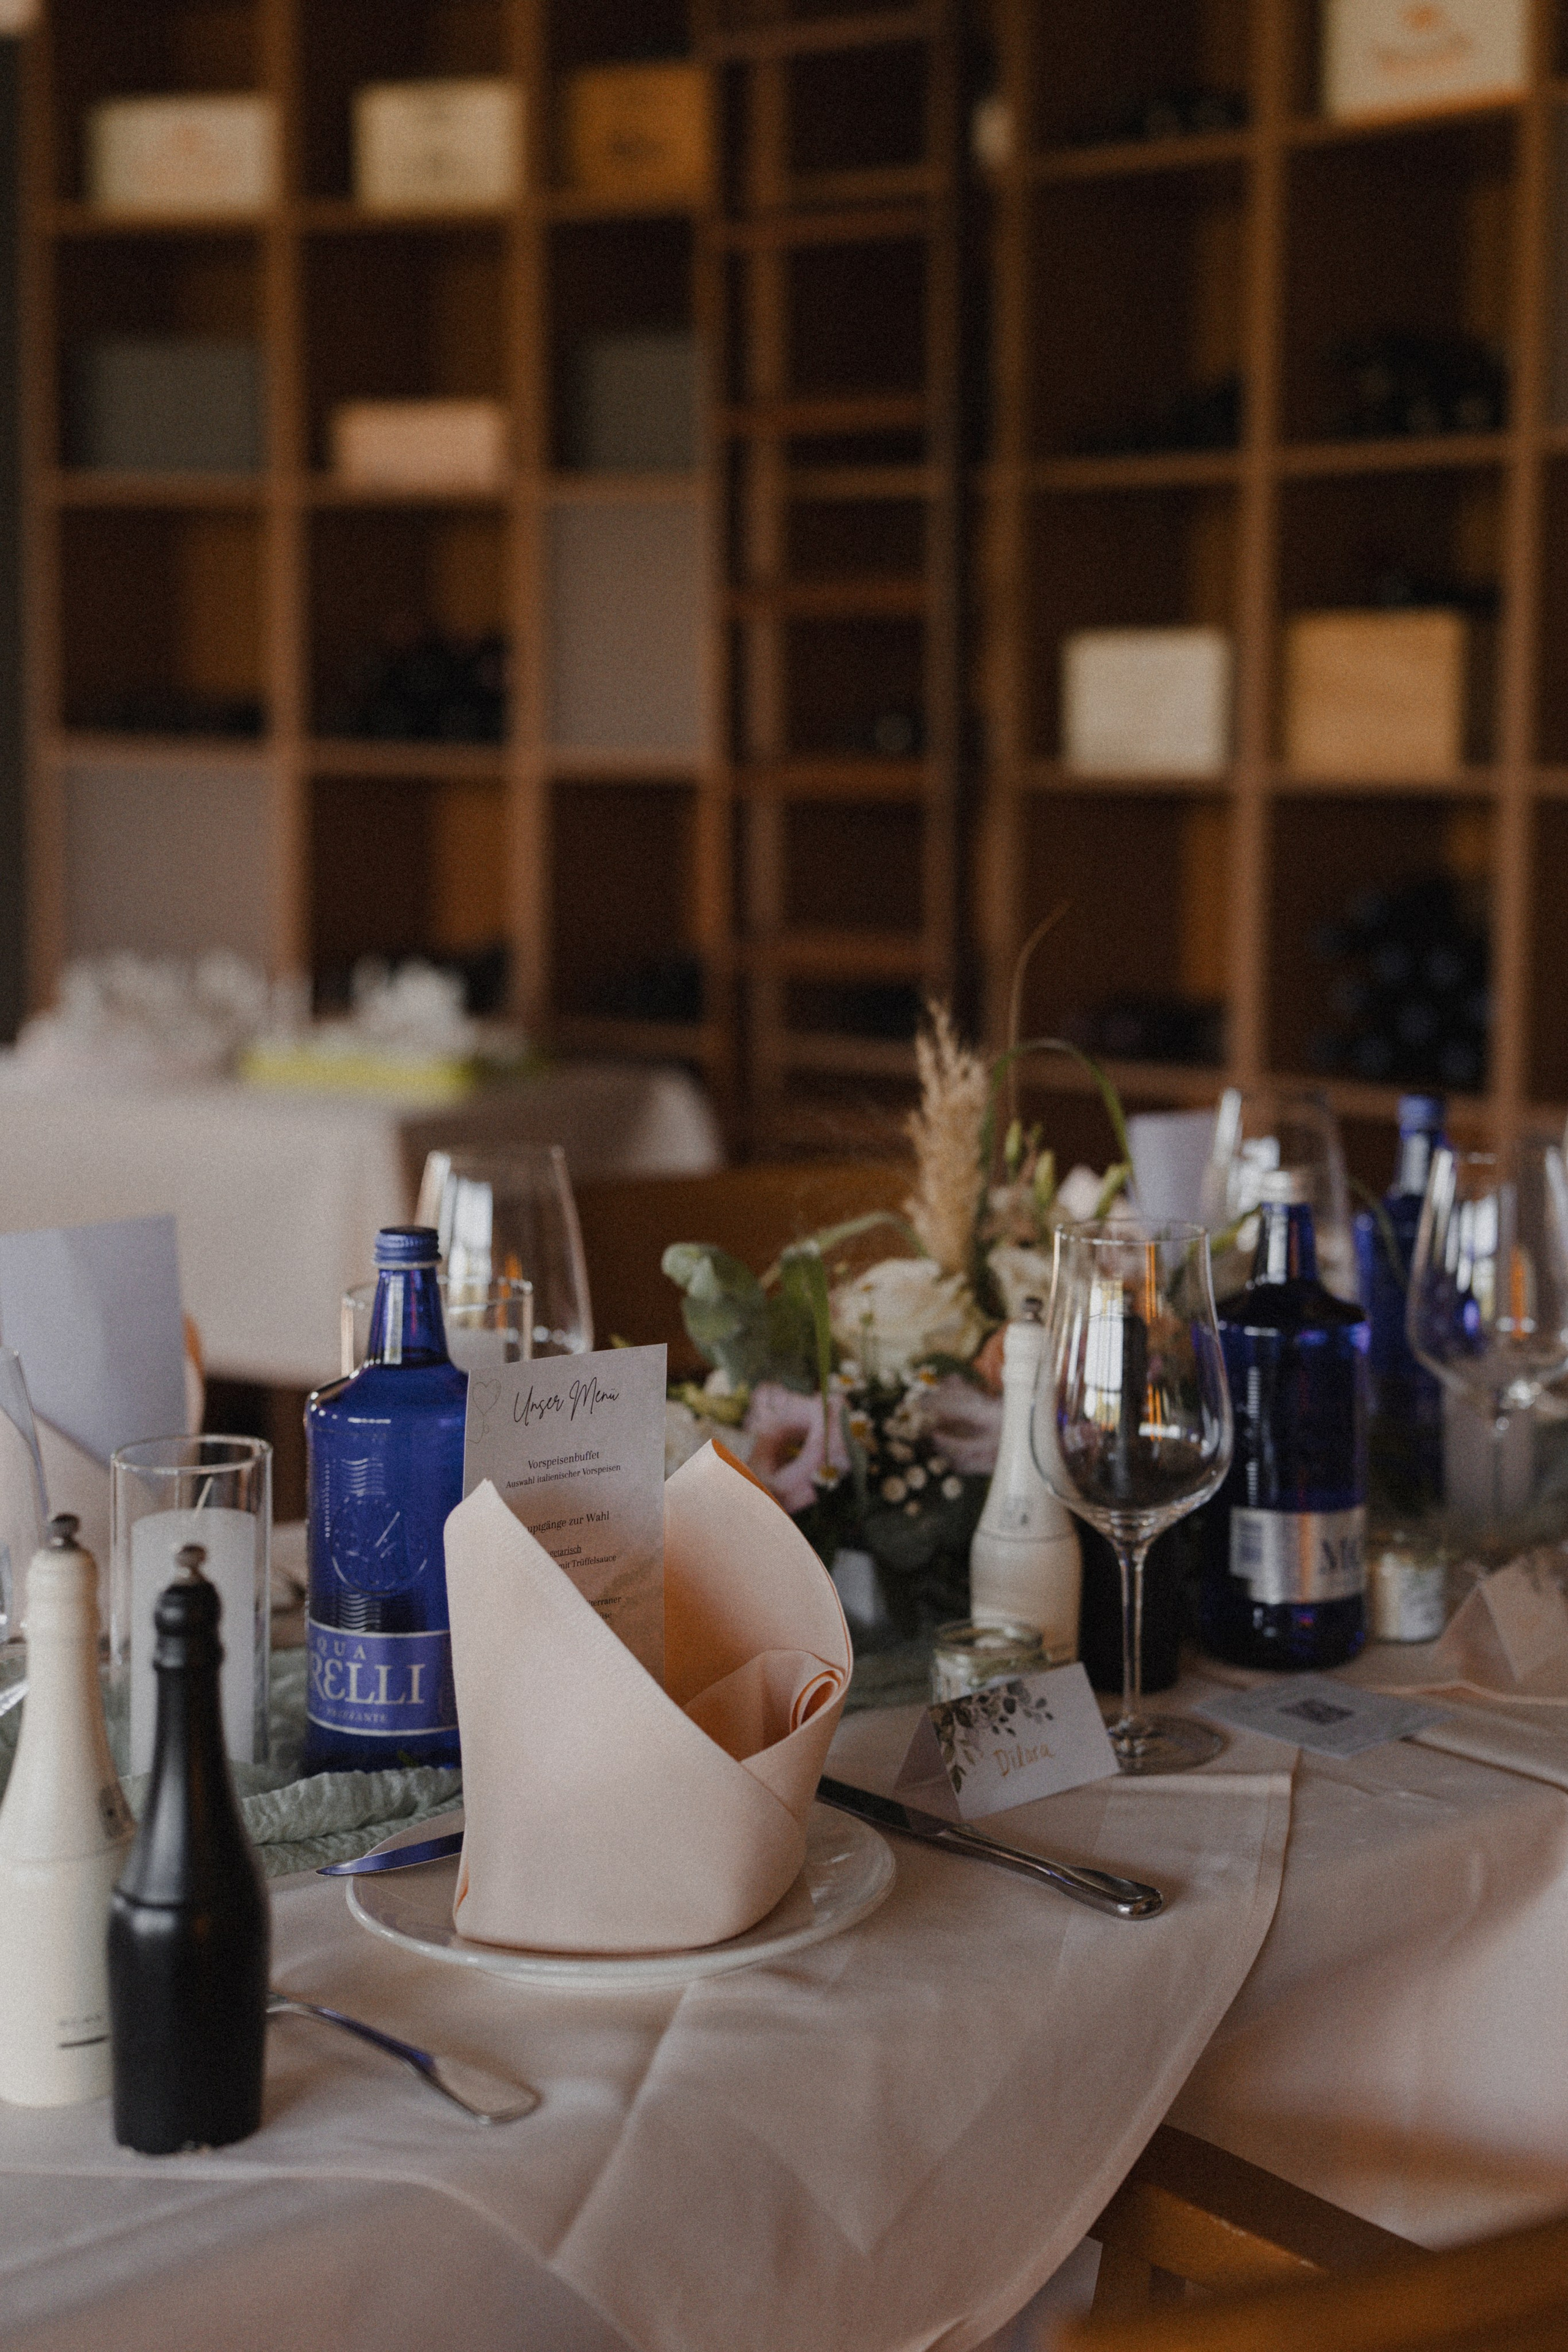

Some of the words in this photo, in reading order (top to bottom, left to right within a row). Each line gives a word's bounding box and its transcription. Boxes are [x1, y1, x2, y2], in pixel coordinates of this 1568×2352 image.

[569, 1377, 620, 1421] Menü
[528, 1451, 600, 1469] Vorspeisenbuffet
[505, 1476, 535, 1489] Auswahl
[537, 1469, 581, 1483] italienischer
[582, 1464, 621, 1477] Vorspeisen
[527, 1520, 567, 1535] uptgänge
[568, 1517, 584, 1526] zur
[586, 1510, 609, 1523] Wahl
[548, 1544, 582, 1558] getarisch
[571, 1555, 617, 1568] Trüffelsauce
[317, 1636, 367, 1660] QUA
[309, 1650, 426, 1705] RELLI
